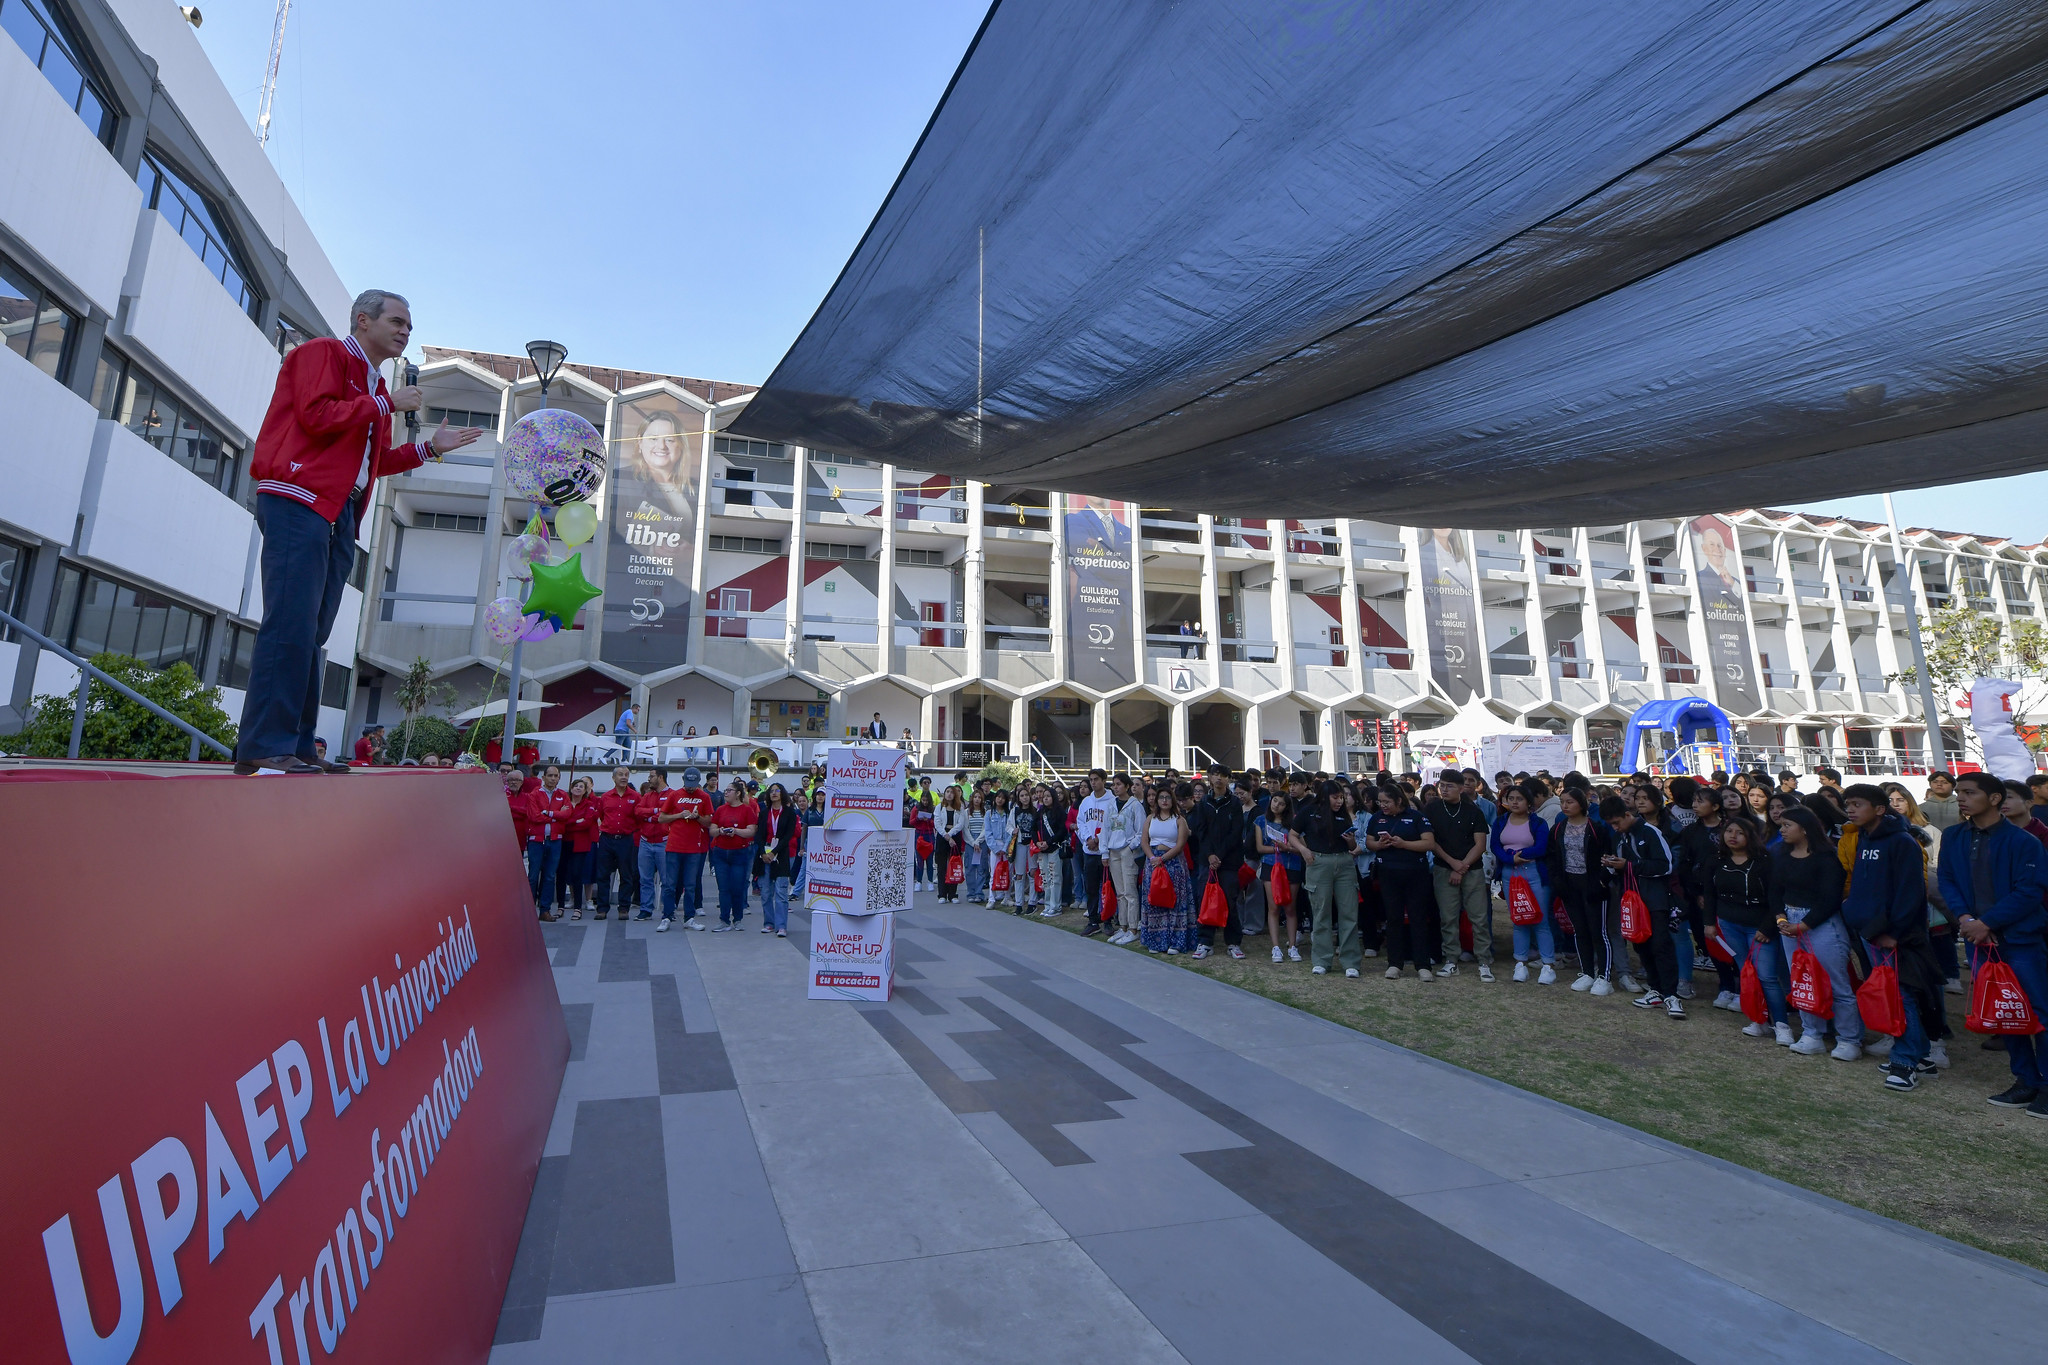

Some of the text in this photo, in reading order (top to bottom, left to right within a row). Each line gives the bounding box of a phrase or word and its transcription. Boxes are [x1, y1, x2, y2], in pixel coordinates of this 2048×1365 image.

[633, 507, 662, 522] valor
[664, 514, 673, 522] de
[625, 523, 680, 548] libre
[1082, 544, 1105, 557] valor
[629, 554, 673, 566] FLORENCE
[1068, 556, 1131, 570] respetuoso
[627, 565, 674, 576] GROLLEAU
[635, 577, 664, 587] Decana
[1081, 586, 1119, 596] GUILLERMO
[1080, 595, 1120, 605] TEPANÉCATL
[630, 597, 665, 622] 50
[1086, 606, 1115, 615] Estudiante
[1706, 609, 1745, 622] solidario
[1088, 623, 1115, 645] 50
[1174, 671, 1189, 690] A
[832, 767, 897, 781] MATCH UP
[848, 799, 892, 808] vocación
[823, 845, 842, 853] UPAEP
[809, 852, 856, 868] MATCH UP
[810, 884, 852, 897] tu vocación
[836, 934, 863, 942] UPAEP
[816, 942, 882, 957] MATCH UP
[820, 976, 878, 986] tu vocación
[1792, 989, 1806, 999] de
[2001, 989, 2019, 999] Se
[1994, 999, 2024, 1010] trata
[1995, 1009, 2026, 1019] de ti
[42, 904, 479, 1365] UPAEP La Universidad
[248, 1025, 484, 1365] Transformadora
